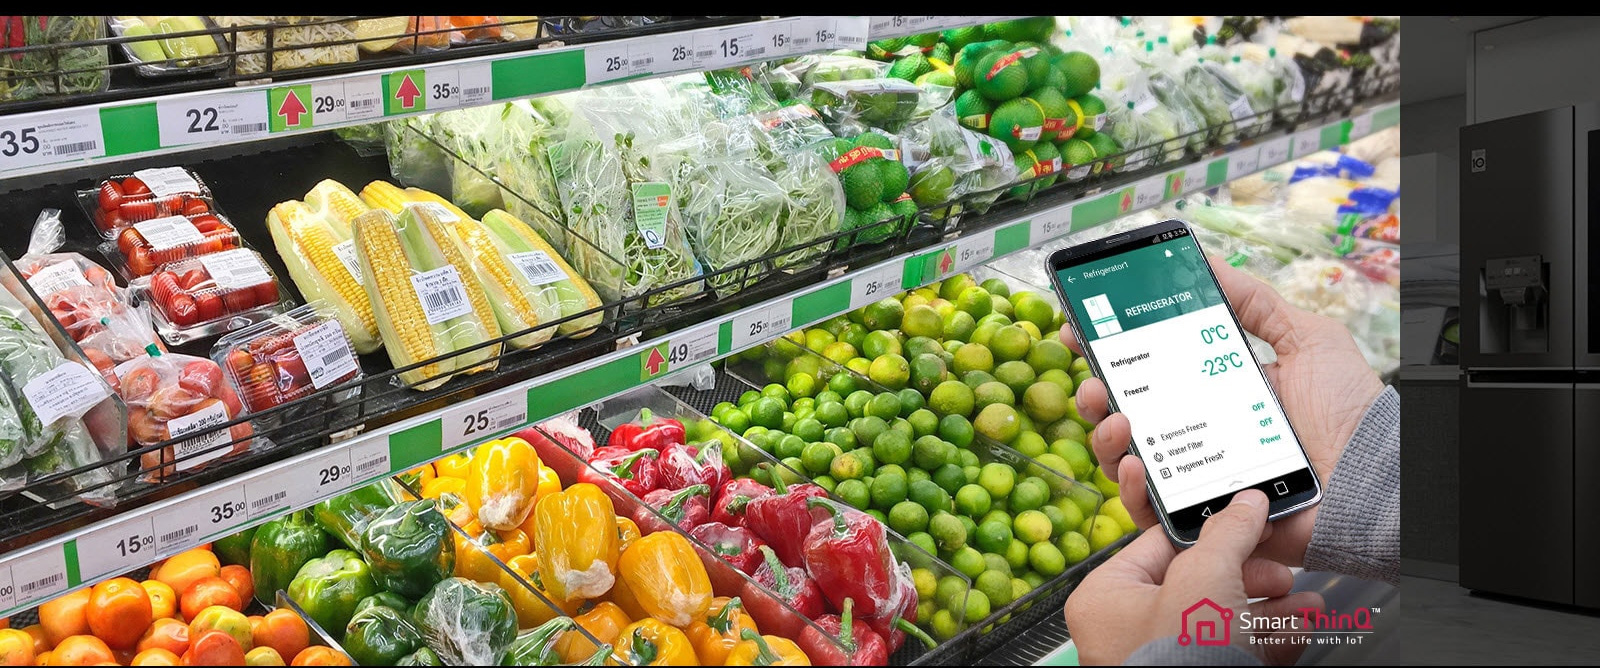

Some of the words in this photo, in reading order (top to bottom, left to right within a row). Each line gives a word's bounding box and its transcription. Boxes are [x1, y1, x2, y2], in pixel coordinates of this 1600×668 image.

[720, 37, 739, 58] 15
[186, 107, 220, 134] 22
[0, 127, 40, 157] 35
[1083, 261, 1129, 280] Refrigerator1
[1124, 291, 1193, 318] REFRIGERATOR
[1200, 324, 1229, 345] 0°C
[668, 343, 688, 365] 49
[1110, 351, 1151, 369] Refrigerator
[1201, 351, 1243, 377] -23°C
[1123, 384, 1150, 398] Freezer
[1252, 401, 1266, 412] OFF
[463, 409, 490, 437] 25
[1160, 427, 1187, 443] Express
[1186, 421, 1208, 433] Freeze
[1259, 417, 1273, 427] OFF
[1167, 444, 1187, 457] Water
[1187, 440, 1204, 451] Filter
[1259, 433, 1282, 445] Power
[1176, 457, 1204, 474] Hygiene
